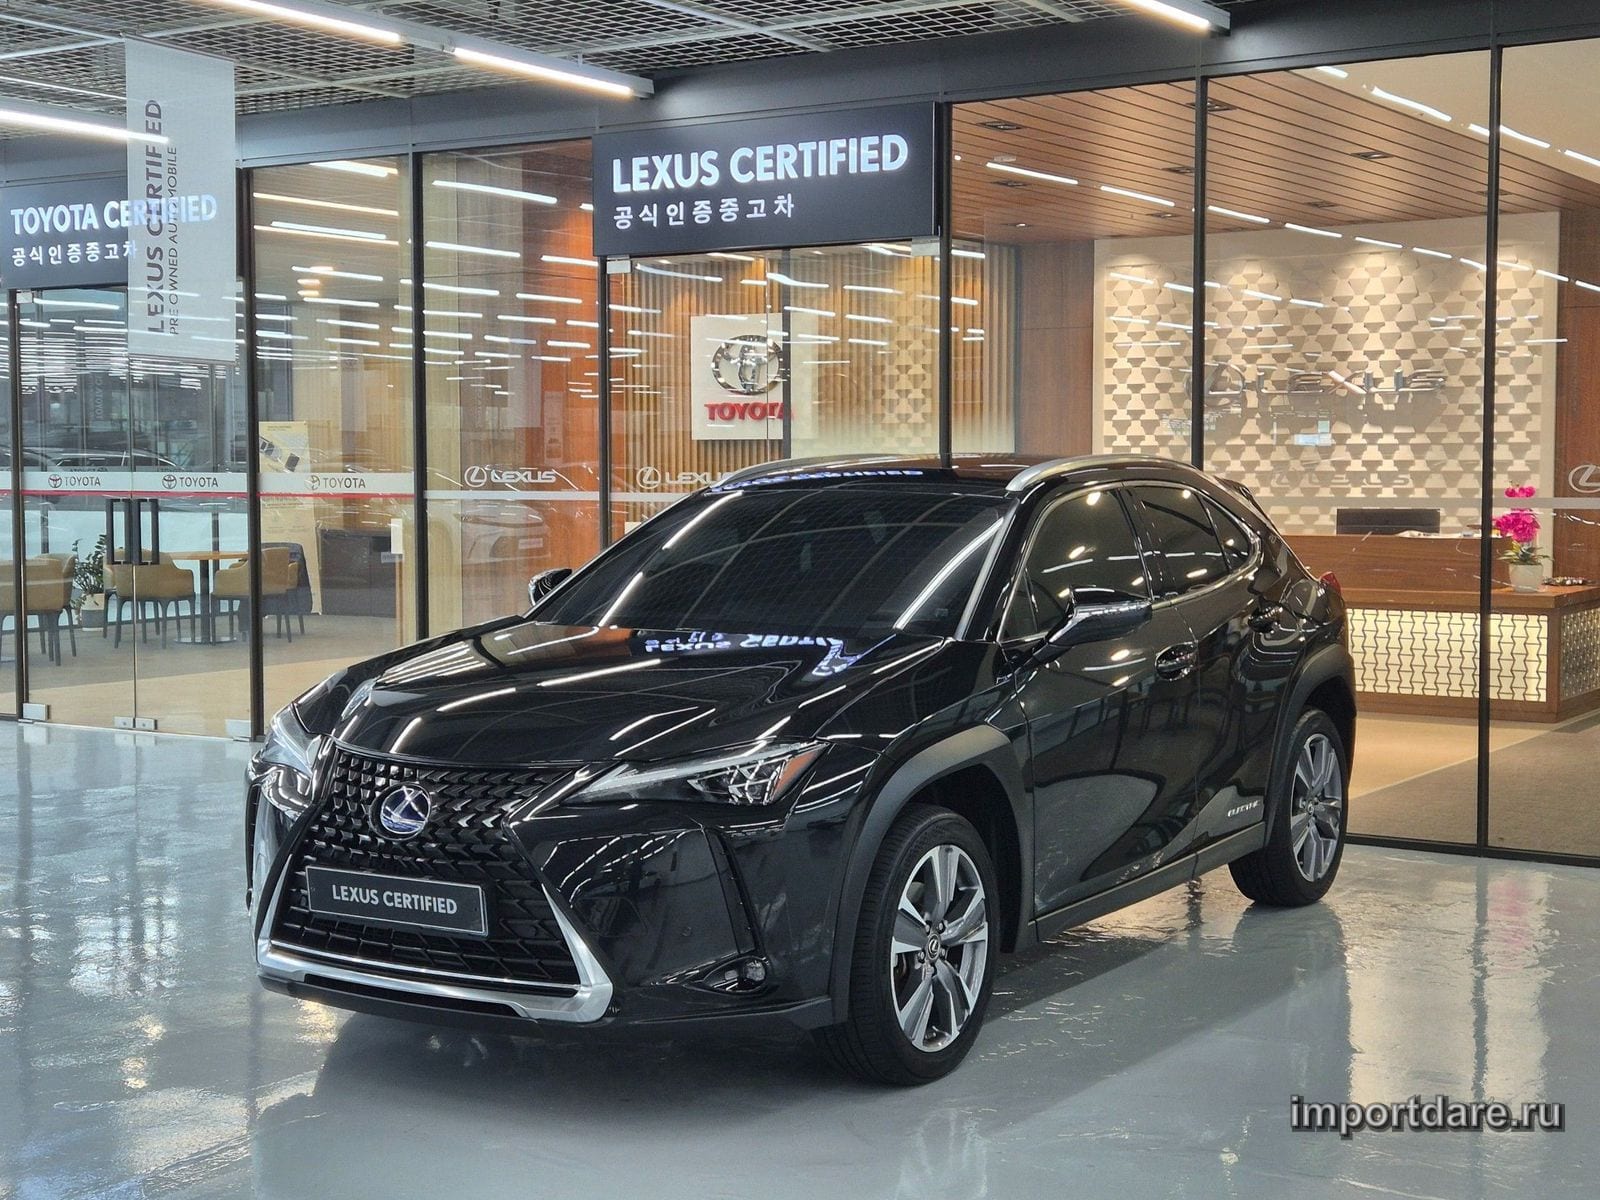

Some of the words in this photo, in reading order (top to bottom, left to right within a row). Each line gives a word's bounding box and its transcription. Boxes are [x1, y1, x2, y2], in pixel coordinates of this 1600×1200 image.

[145, 100, 163, 237] CERTIFED
[612, 150, 720, 193] LEXUS
[729, 134, 908, 184] CERTIFIED
[166, 147, 178, 244] AUTOMOBILE
[10, 203, 99, 235] TOYOTA
[103, 194, 217, 229] CERTIFIED
[146, 245, 164, 334] LEXUS
[167, 248, 178, 305] OWNED
[168, 308, 179, 335] PRE
[64, 476, 101, 487] TOYOTA
[178, 476, 218, 488] TOYOTA
[323, 477, 366, 489] TOYOTA
[490, 469, 557, 484] LEXUS
[332, 884, 379, 905] LEXUS
[382, 891, 458, 915] CERTIFIED
